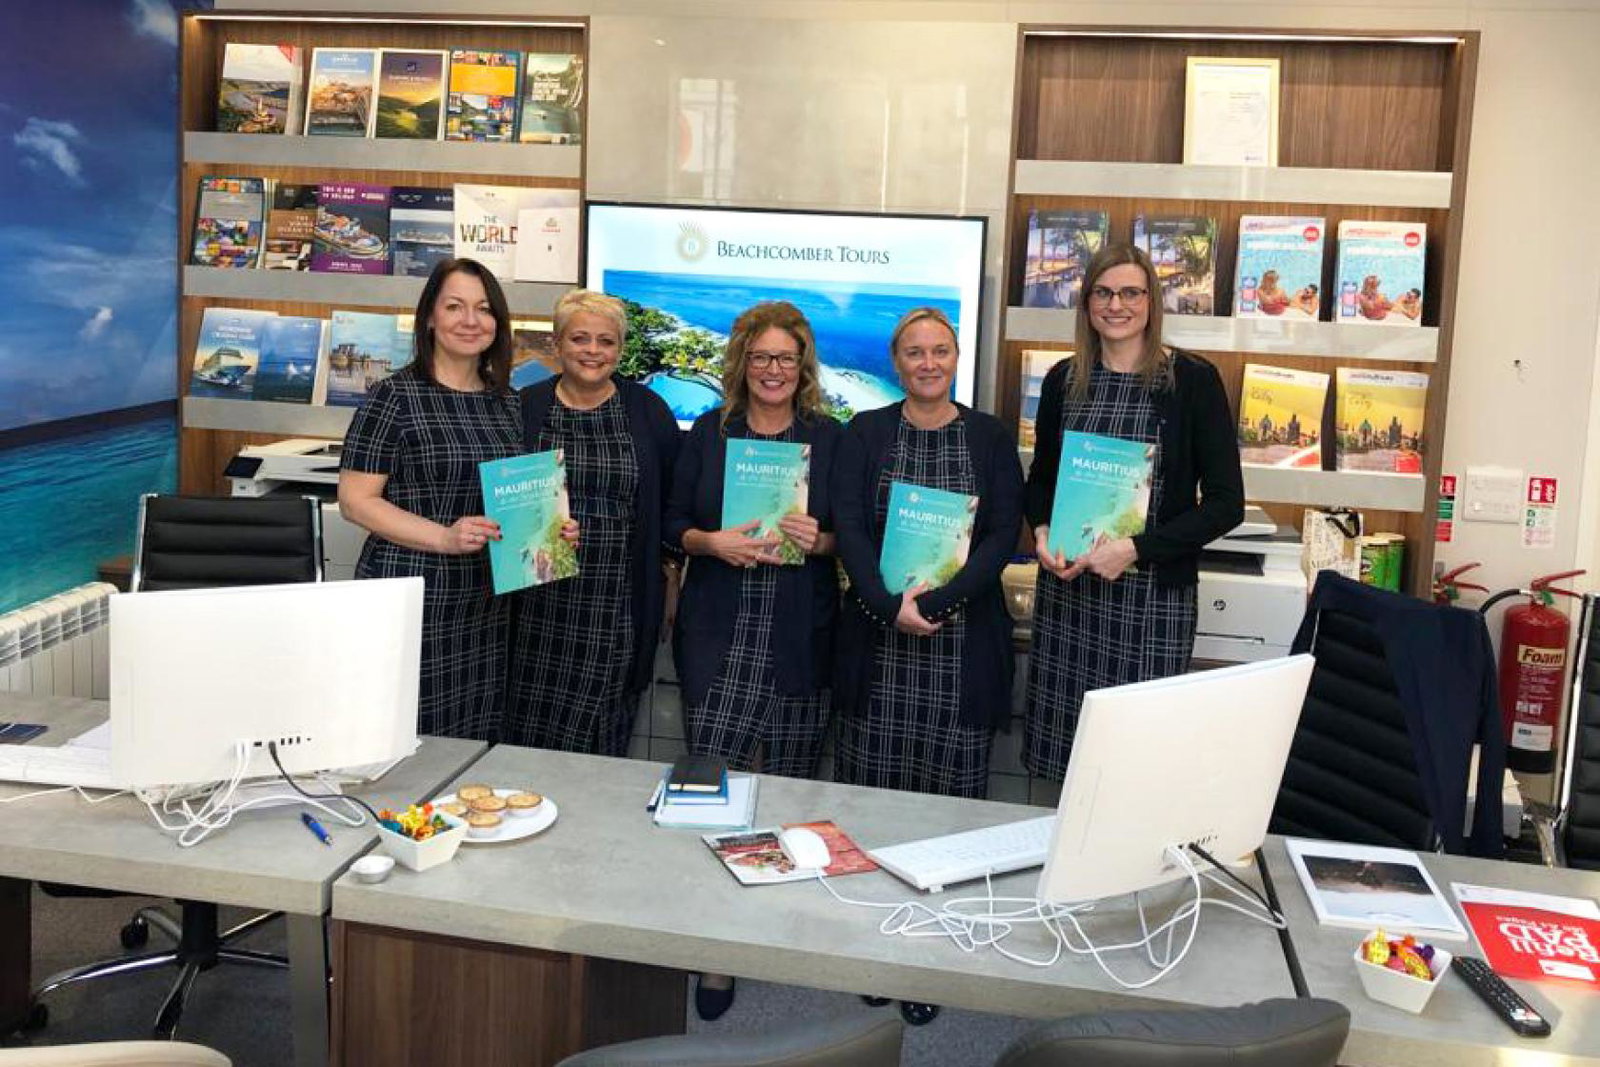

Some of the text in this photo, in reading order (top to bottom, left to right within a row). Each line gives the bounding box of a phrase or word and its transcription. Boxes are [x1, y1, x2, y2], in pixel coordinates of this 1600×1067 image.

[483, 215, 498, 223] THE
[460, 223, 518, 244] WORLD
[475, 243, 505, 254] AWAITS
[717, 240, 890, 265] BEACHCOMBER TOURS
[736, 462, 800, 477] MAURITIUS
[1072, 457, 1140, 478] MAURITIUS
[494, 477, 557, 498] MAURITIUS
[898, 507, 961, 528] MAURITIUS
[1522, 648, 1562, 664] Foam
[1499, 922, 1590, 948] PAD
